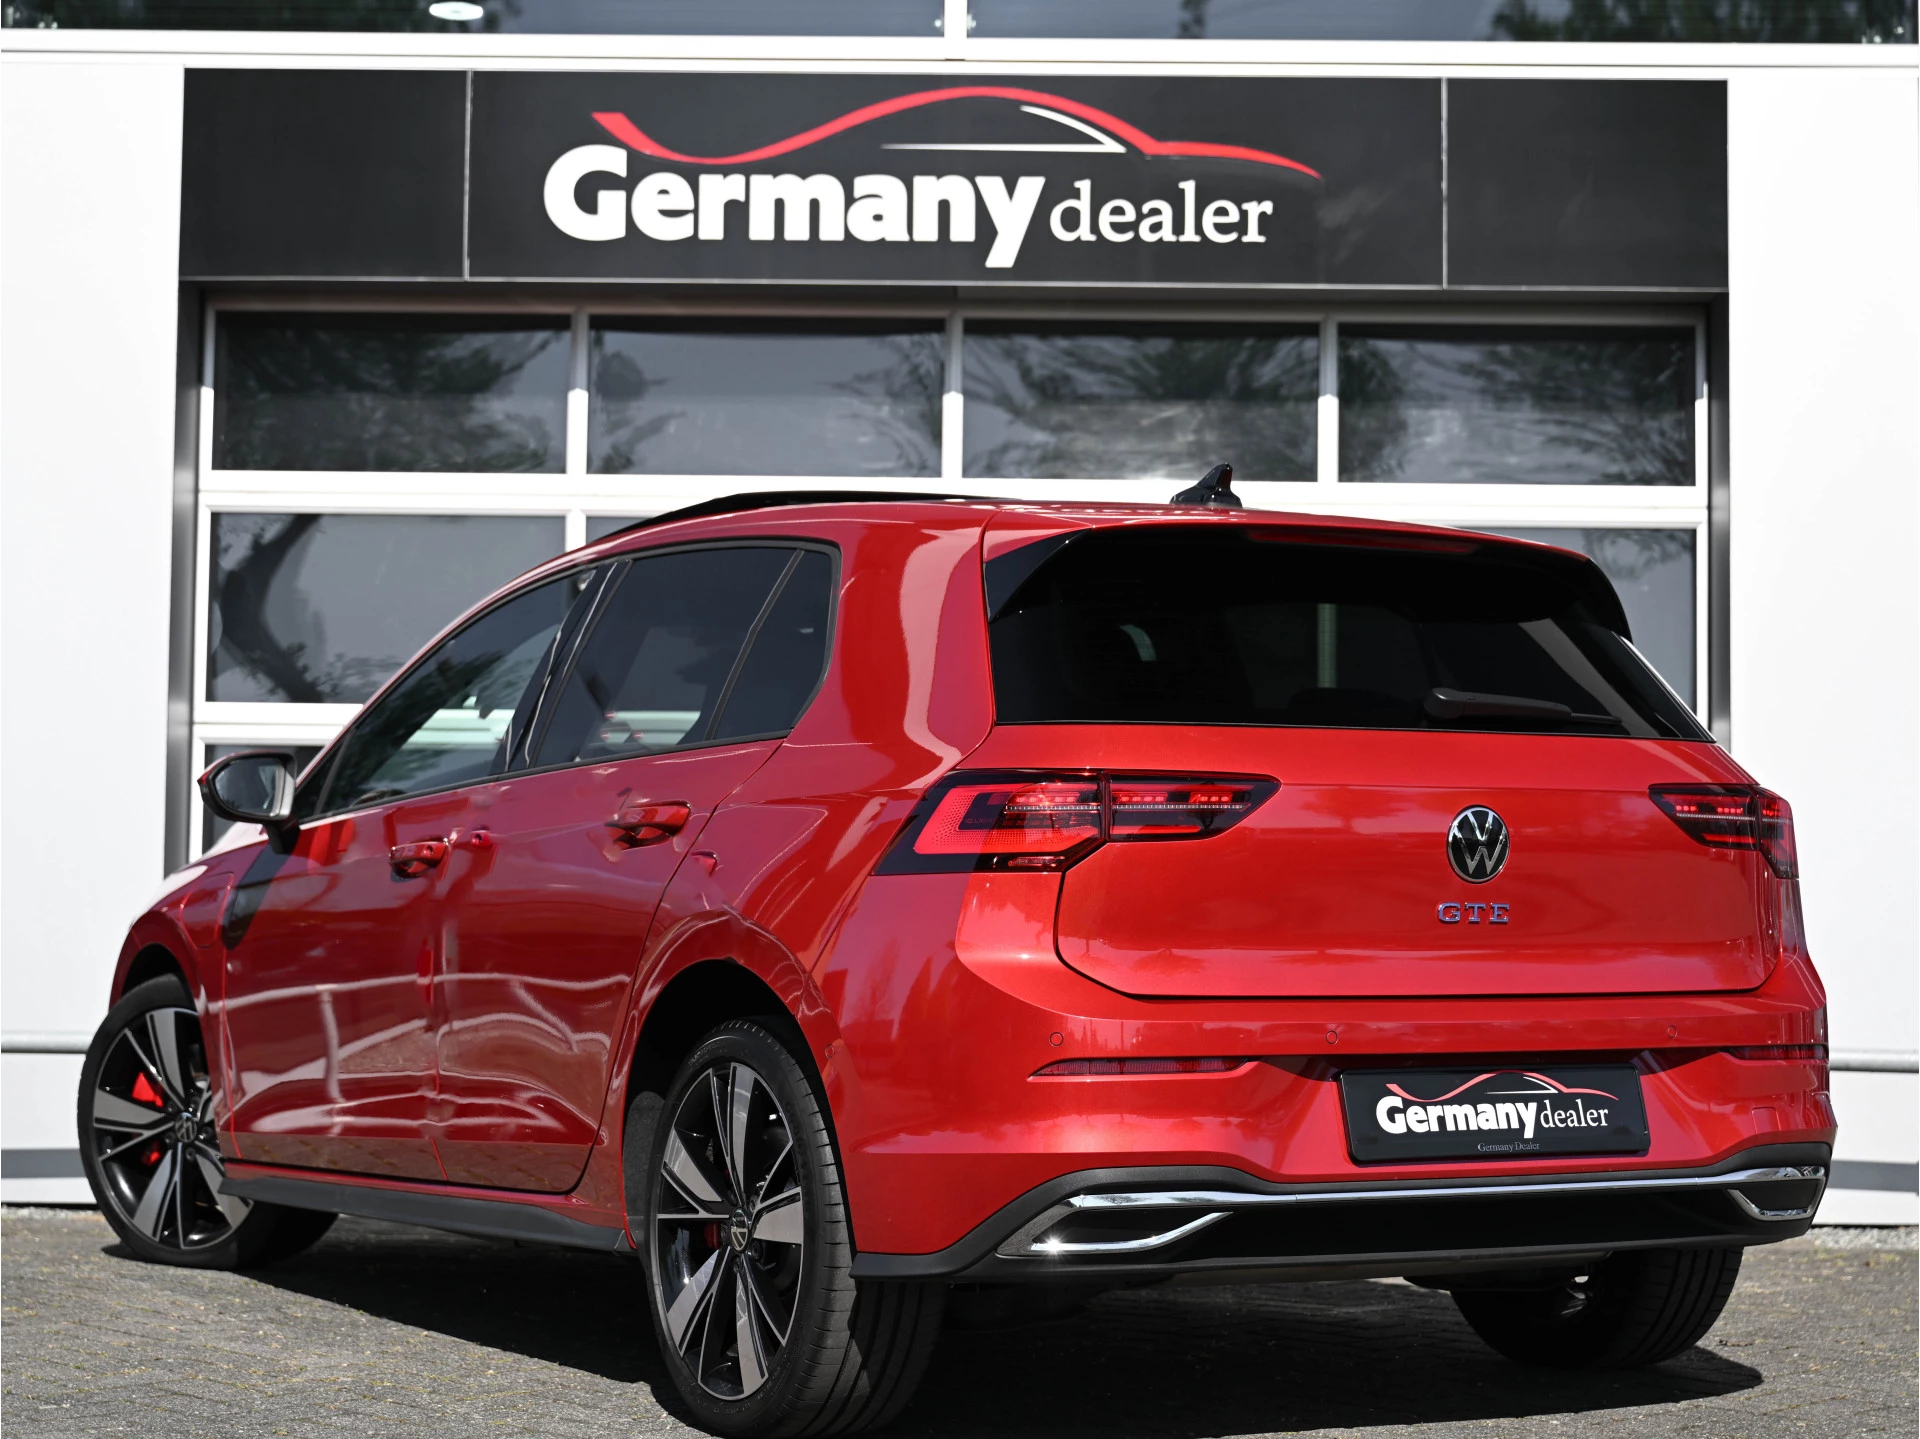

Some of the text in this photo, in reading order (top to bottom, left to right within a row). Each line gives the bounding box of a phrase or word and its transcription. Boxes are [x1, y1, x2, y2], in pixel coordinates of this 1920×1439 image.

[543, 143, 1275, 268] Germany dealer
[1438, 902, 1510, 923] GTE
[1376, 1095, 1609, 1139] Germany dealer
[1477, 1141, 1540, 1152] Germany Dealer
